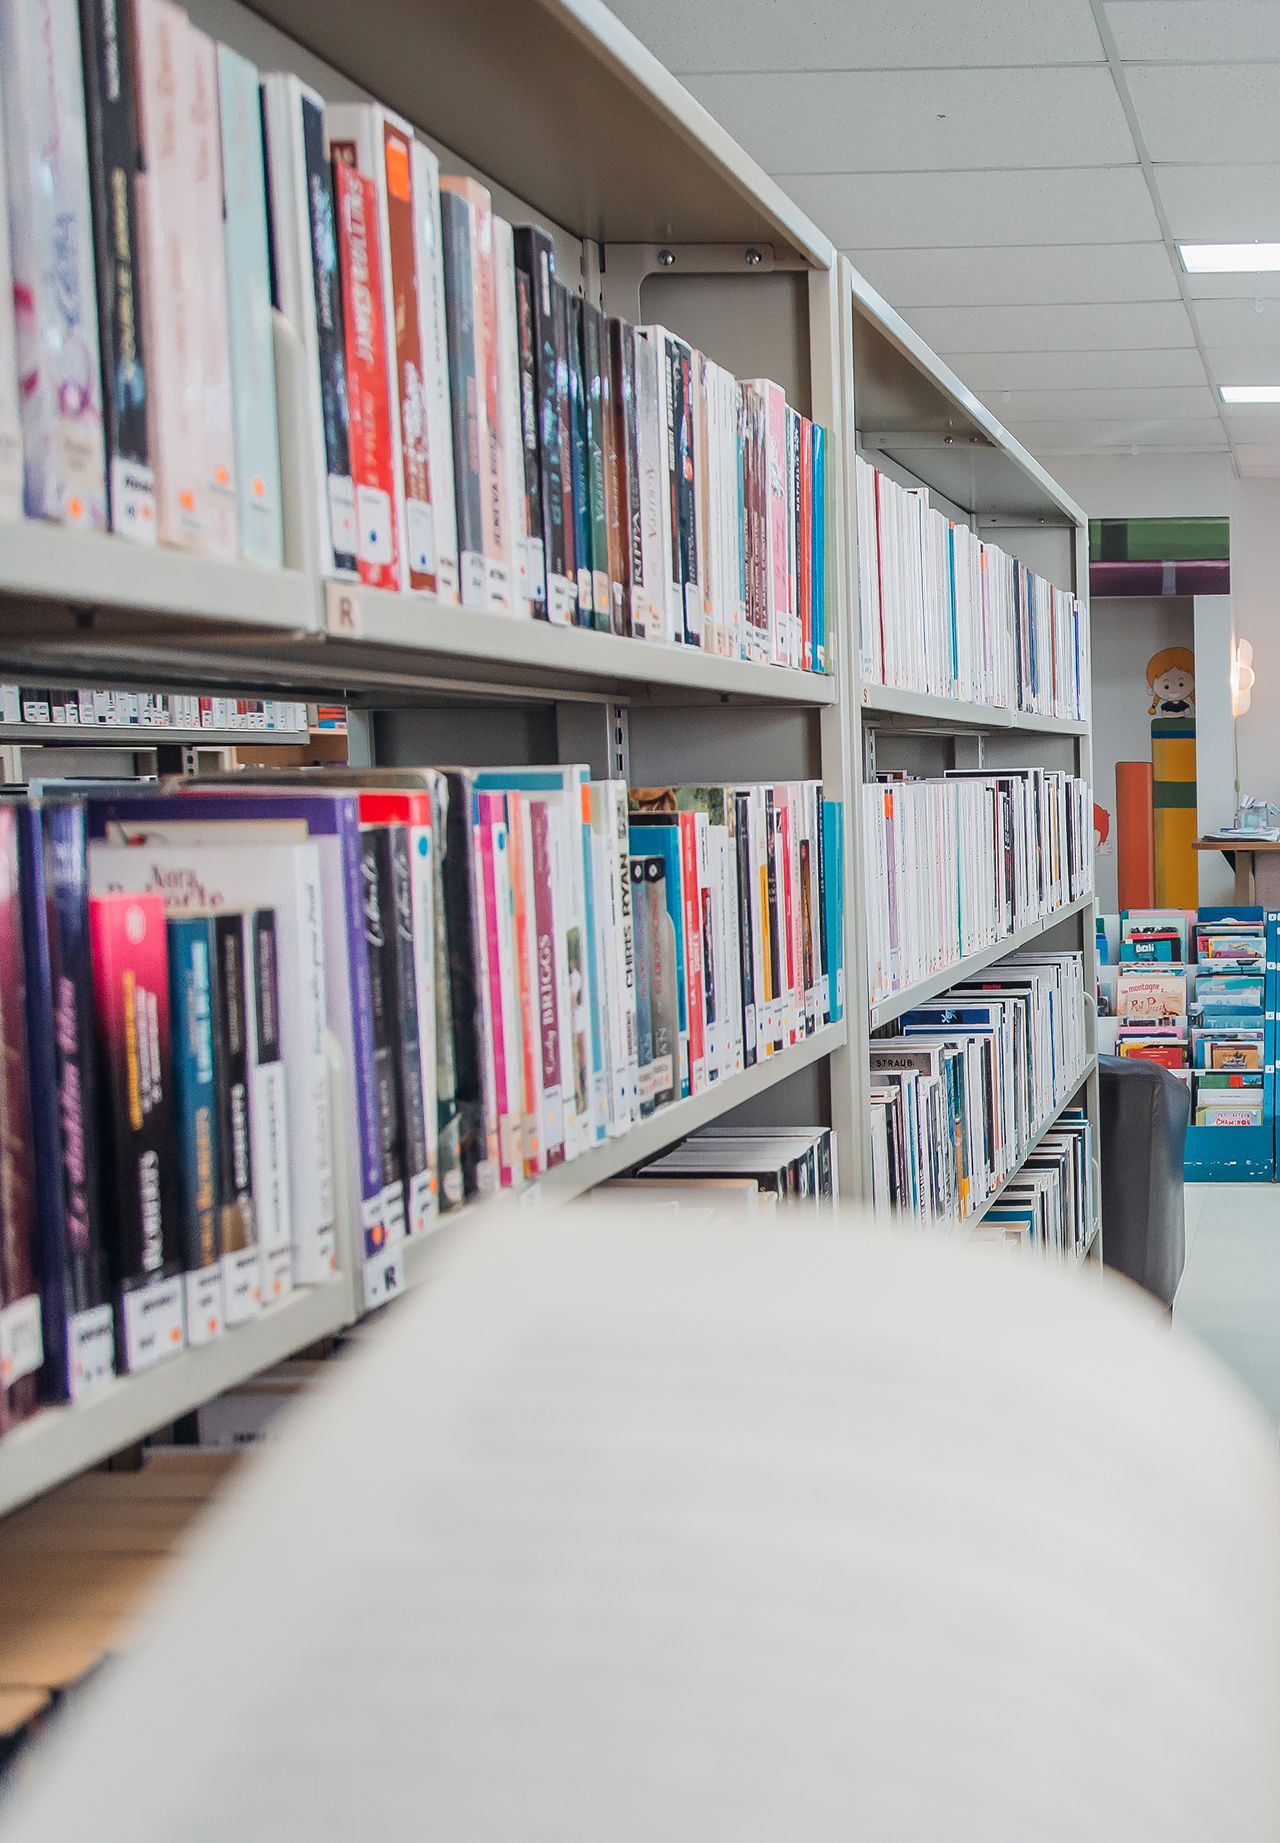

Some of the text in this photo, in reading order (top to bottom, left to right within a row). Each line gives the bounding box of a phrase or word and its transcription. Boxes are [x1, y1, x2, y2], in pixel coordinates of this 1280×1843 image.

[338, 594, 355, 627] R
[620, 852, 633, 989] CHRIS RYAN
[1135, 940, 1155, 953] Bali
[538, 934, 555, 1026] BRIGGS
[1128, 982, 1160, 994] montagne
[876, 1058, 913, 1068] STRAUB
